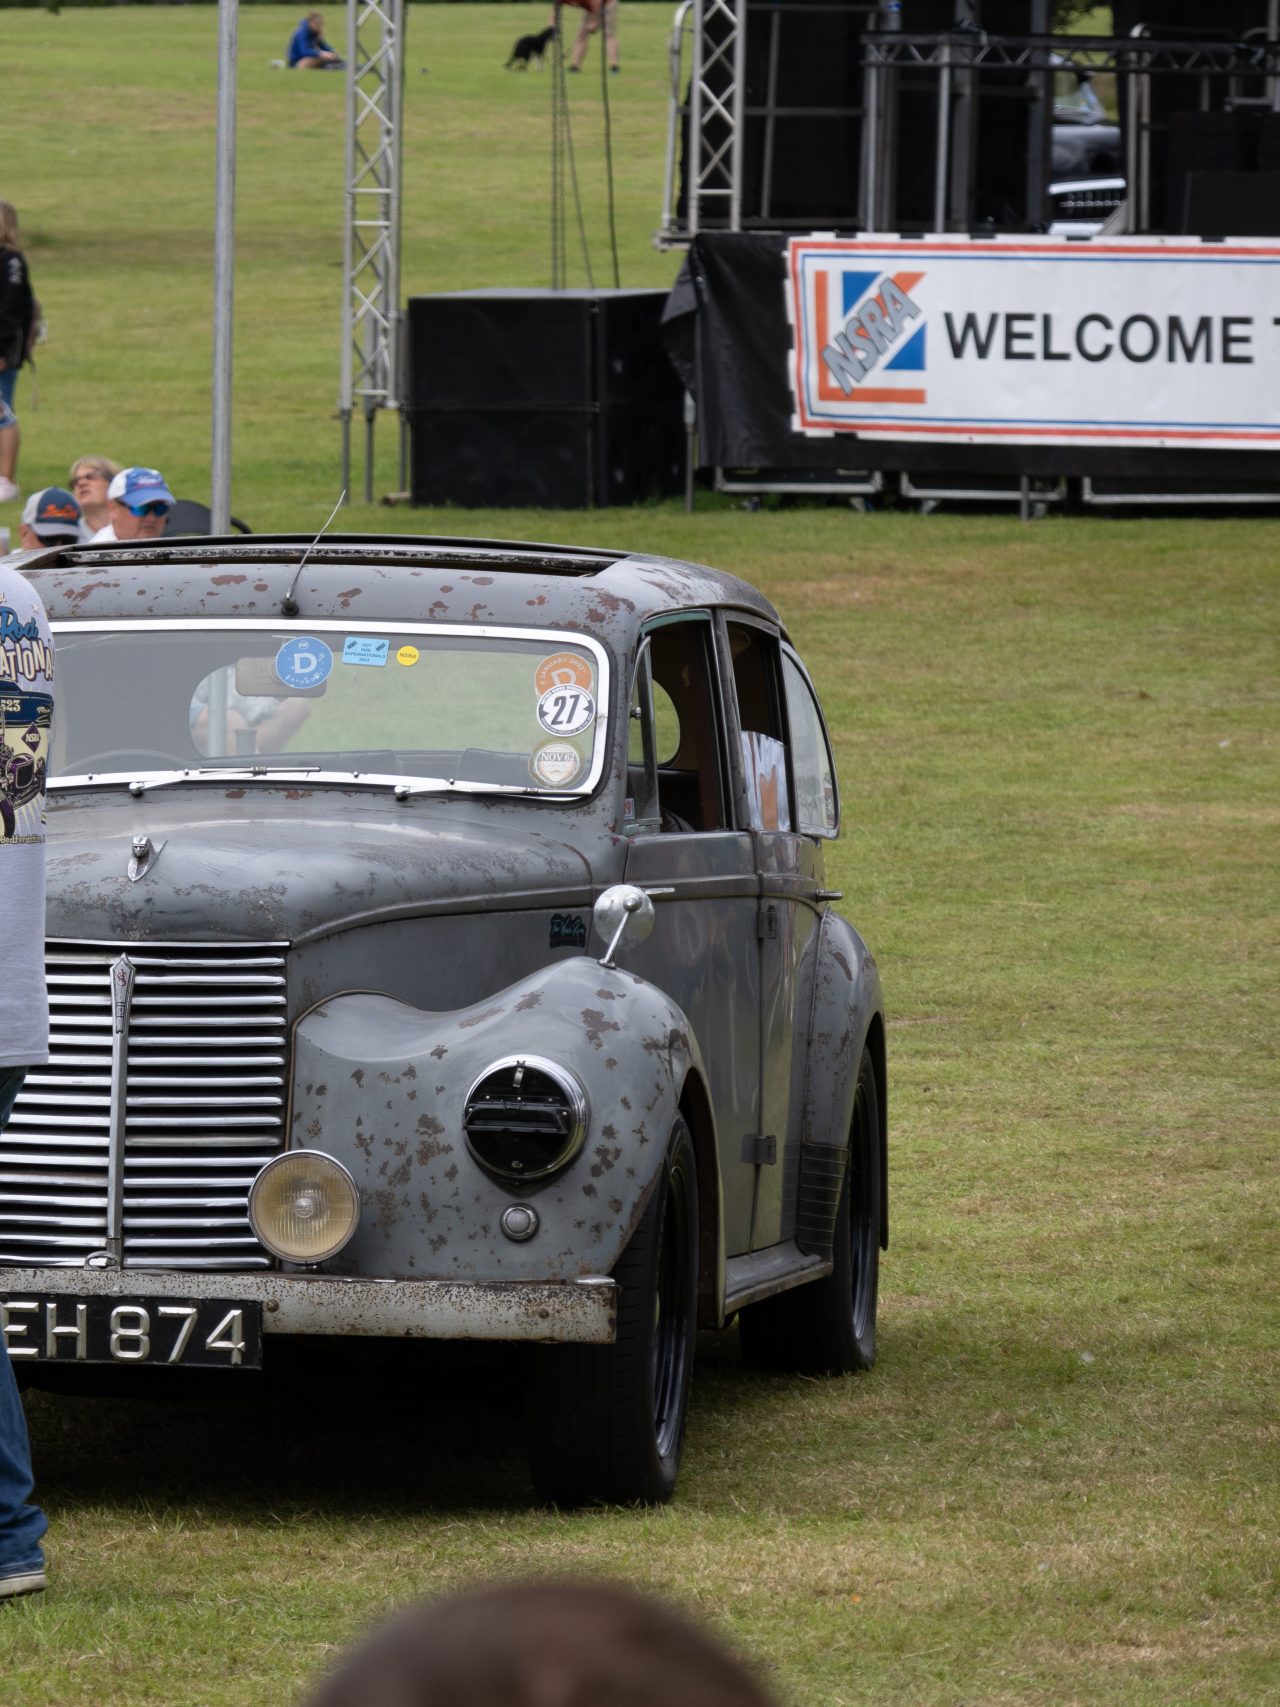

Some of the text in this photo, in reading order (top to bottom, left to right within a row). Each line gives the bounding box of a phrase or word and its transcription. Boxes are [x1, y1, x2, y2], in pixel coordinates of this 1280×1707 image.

[822, 277, 922, 396] NSRA
[944, 311, 1254, 364] WELCOME
[294, 652, 318, 674] D
[550, 693, 581, 726] 27
[541, 752, 575, 761] NOV 62
[0, 1302, 246, 1365] EH 874
